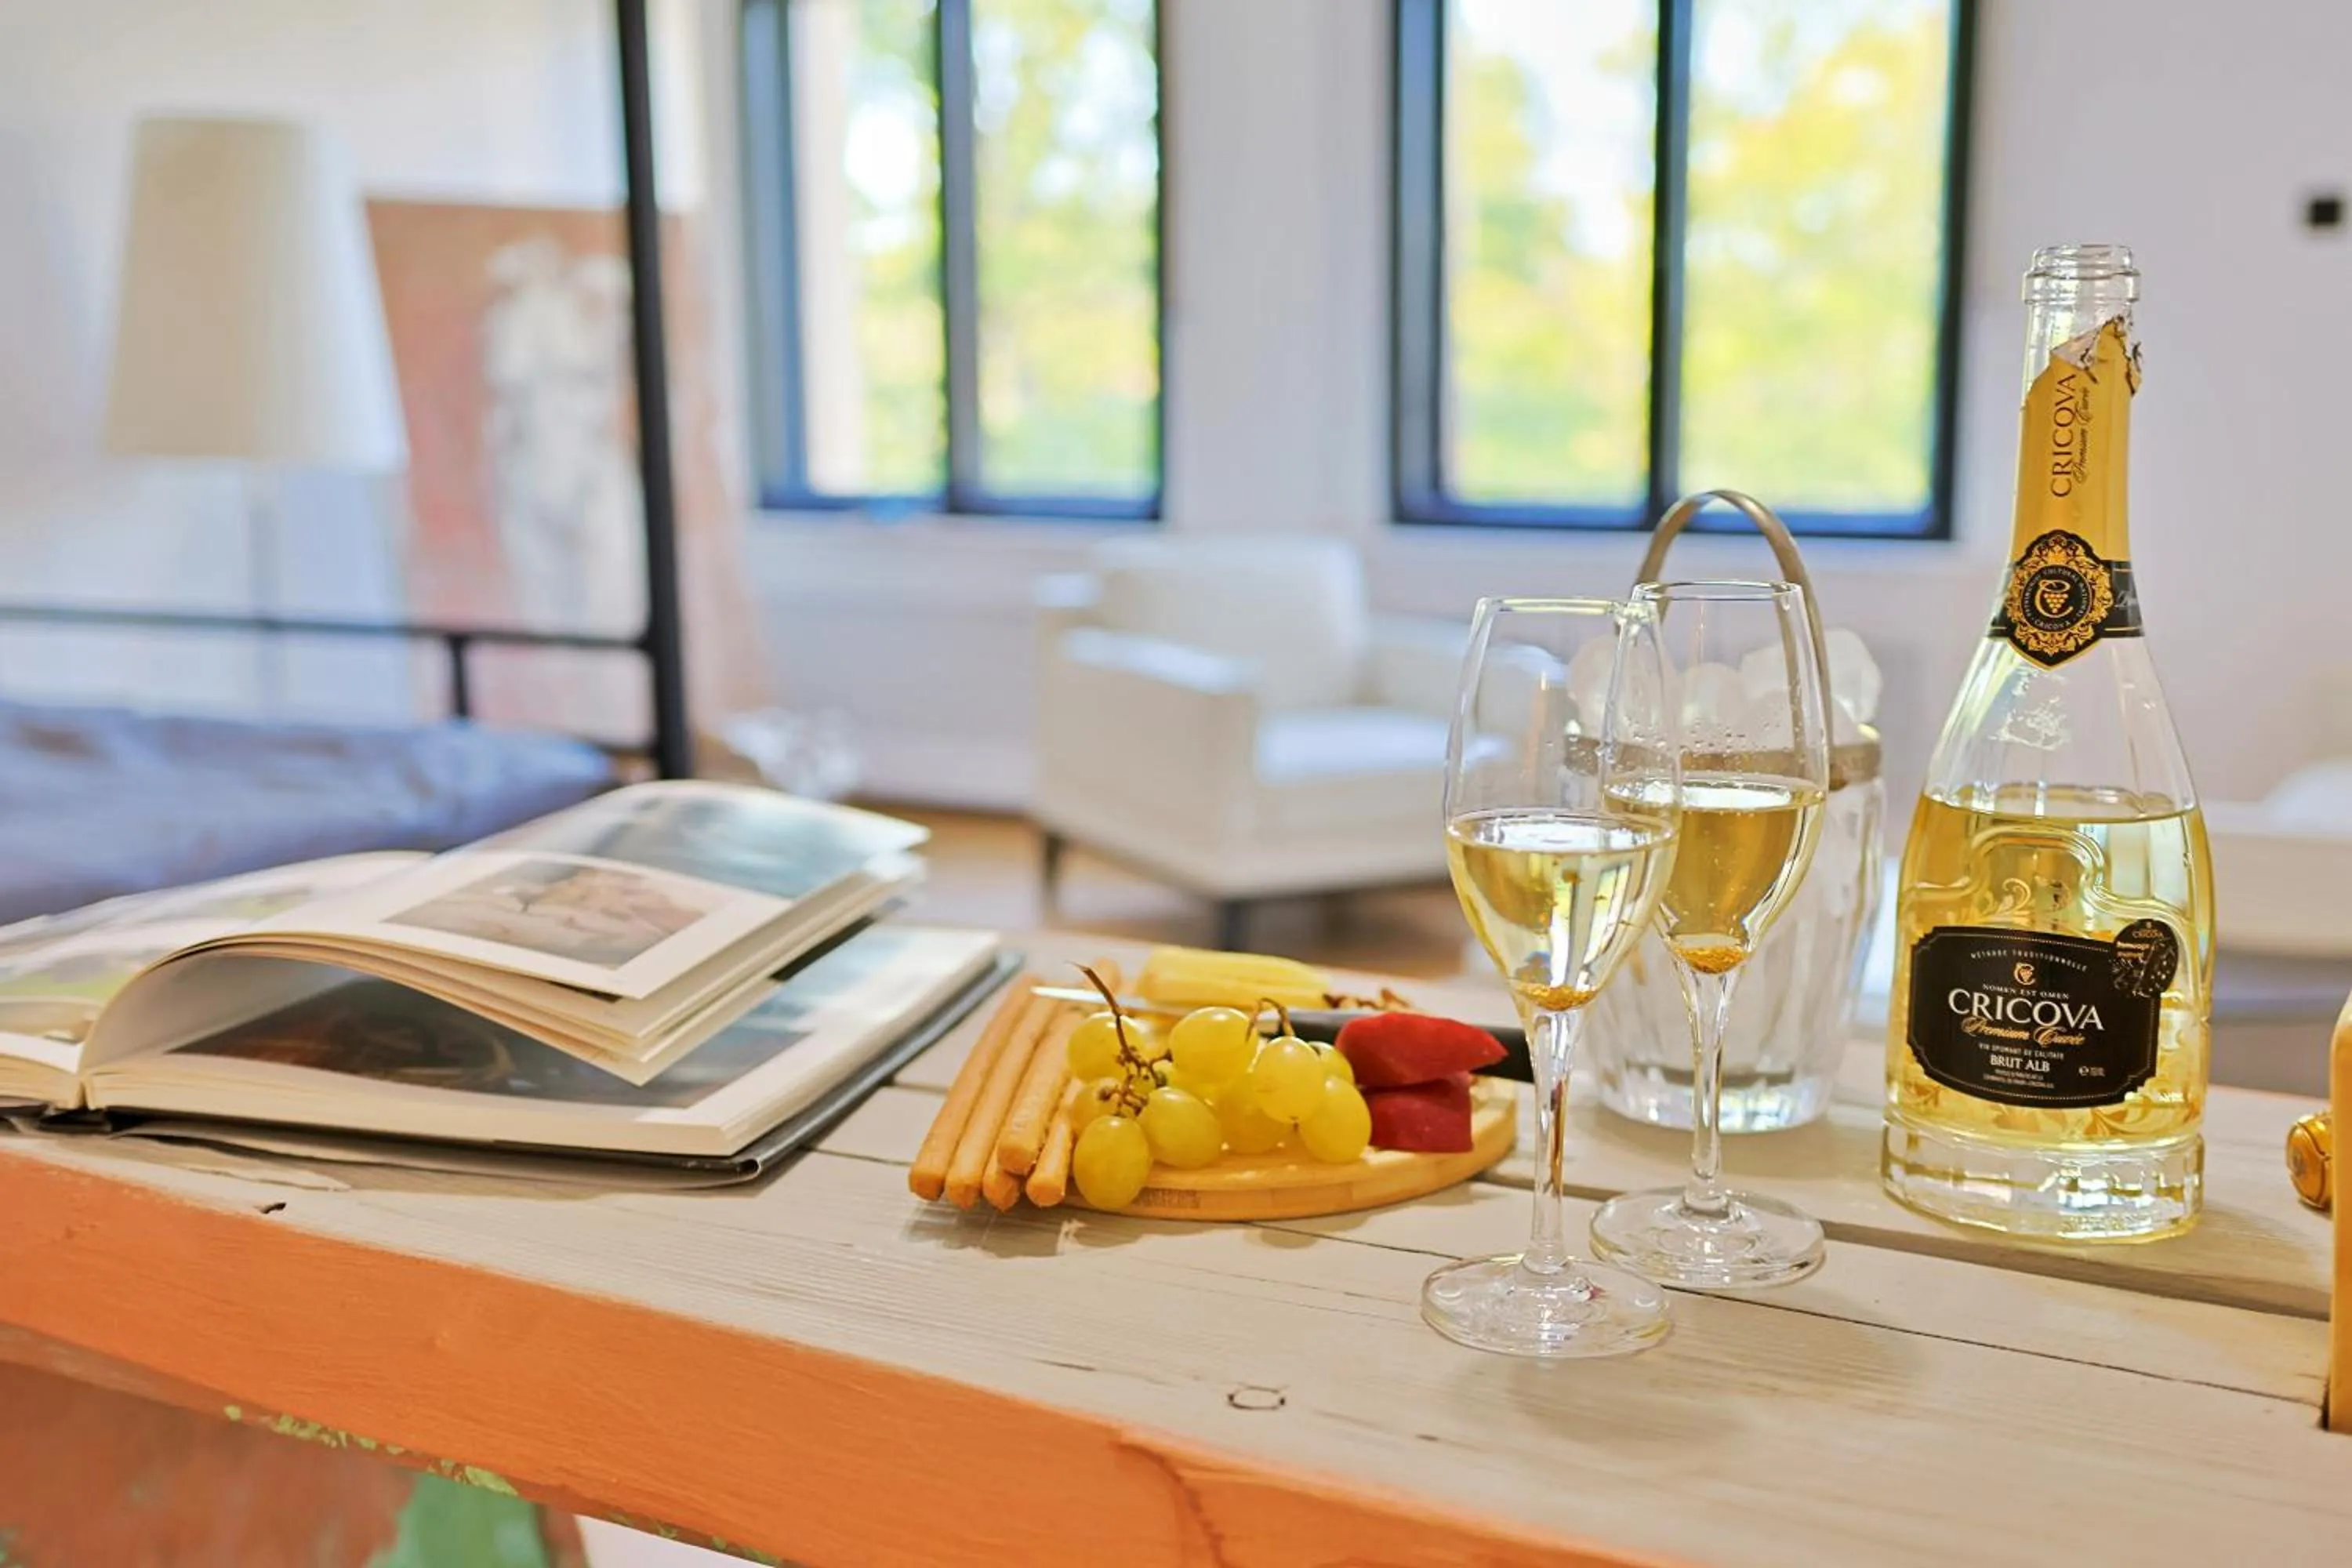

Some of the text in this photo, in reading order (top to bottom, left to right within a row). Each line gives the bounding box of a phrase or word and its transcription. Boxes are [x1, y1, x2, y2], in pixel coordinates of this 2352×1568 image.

[2050, 374, 2076, 498] CRICOVA
[1982, 983, 2016, 994] NOMEN
[2040, 990, 2070, 1000] OMEN
[1948, 988, 2105, 1031] CRICOVA
[1961, 1015, 2030, 1040] Premium
[1990, 1054, 2051, 1073] BRUT ALB
